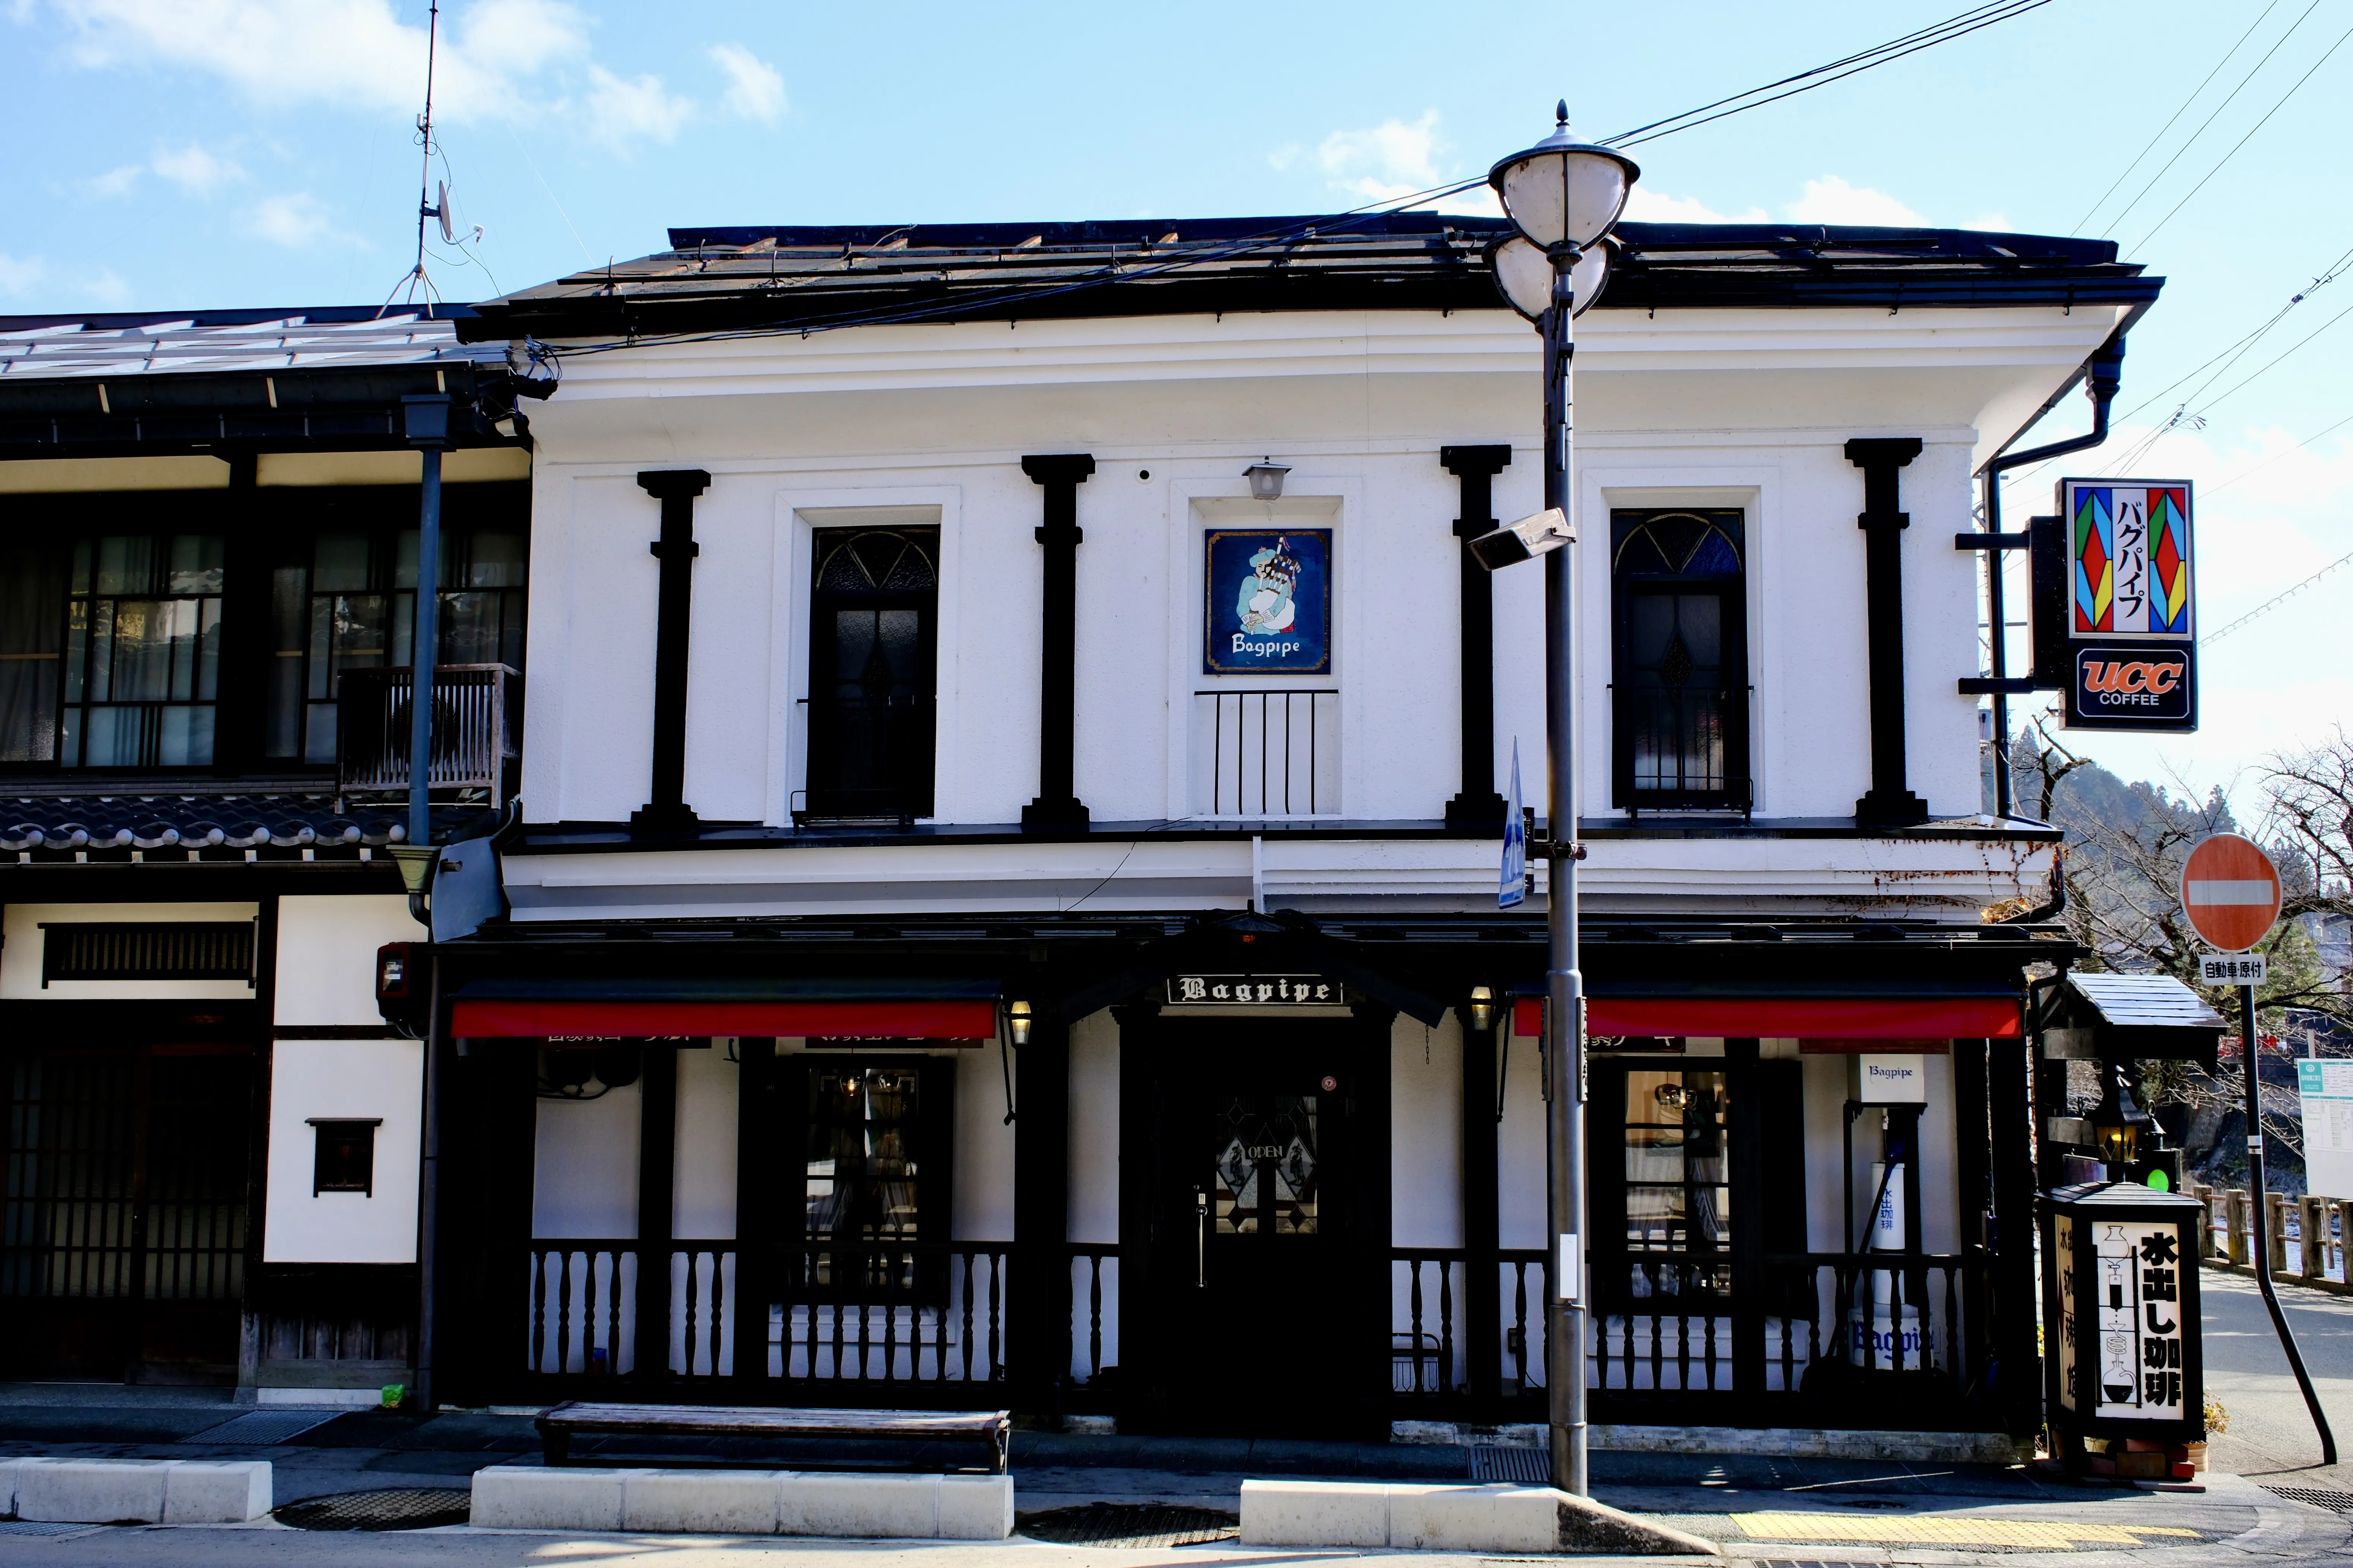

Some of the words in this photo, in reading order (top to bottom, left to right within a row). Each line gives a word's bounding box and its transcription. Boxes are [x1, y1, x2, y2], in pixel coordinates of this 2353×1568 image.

[2117, 501, 2146, 618] バグパイプ
[1232, 633, 1300, 657] Bagpipe
[2099, 693, 2159, 705] COFFEE
[1179, 978, 1330, 1002] Bagpipe
[1869, 1066, 1912, 1082] Bagpipe
[1248, 1146, 1282, 1158] OPEN
[2140, 1232, 2181, 1407] 水出し珈琲
[1852, 1320, 1934, 1361] Bagpi
